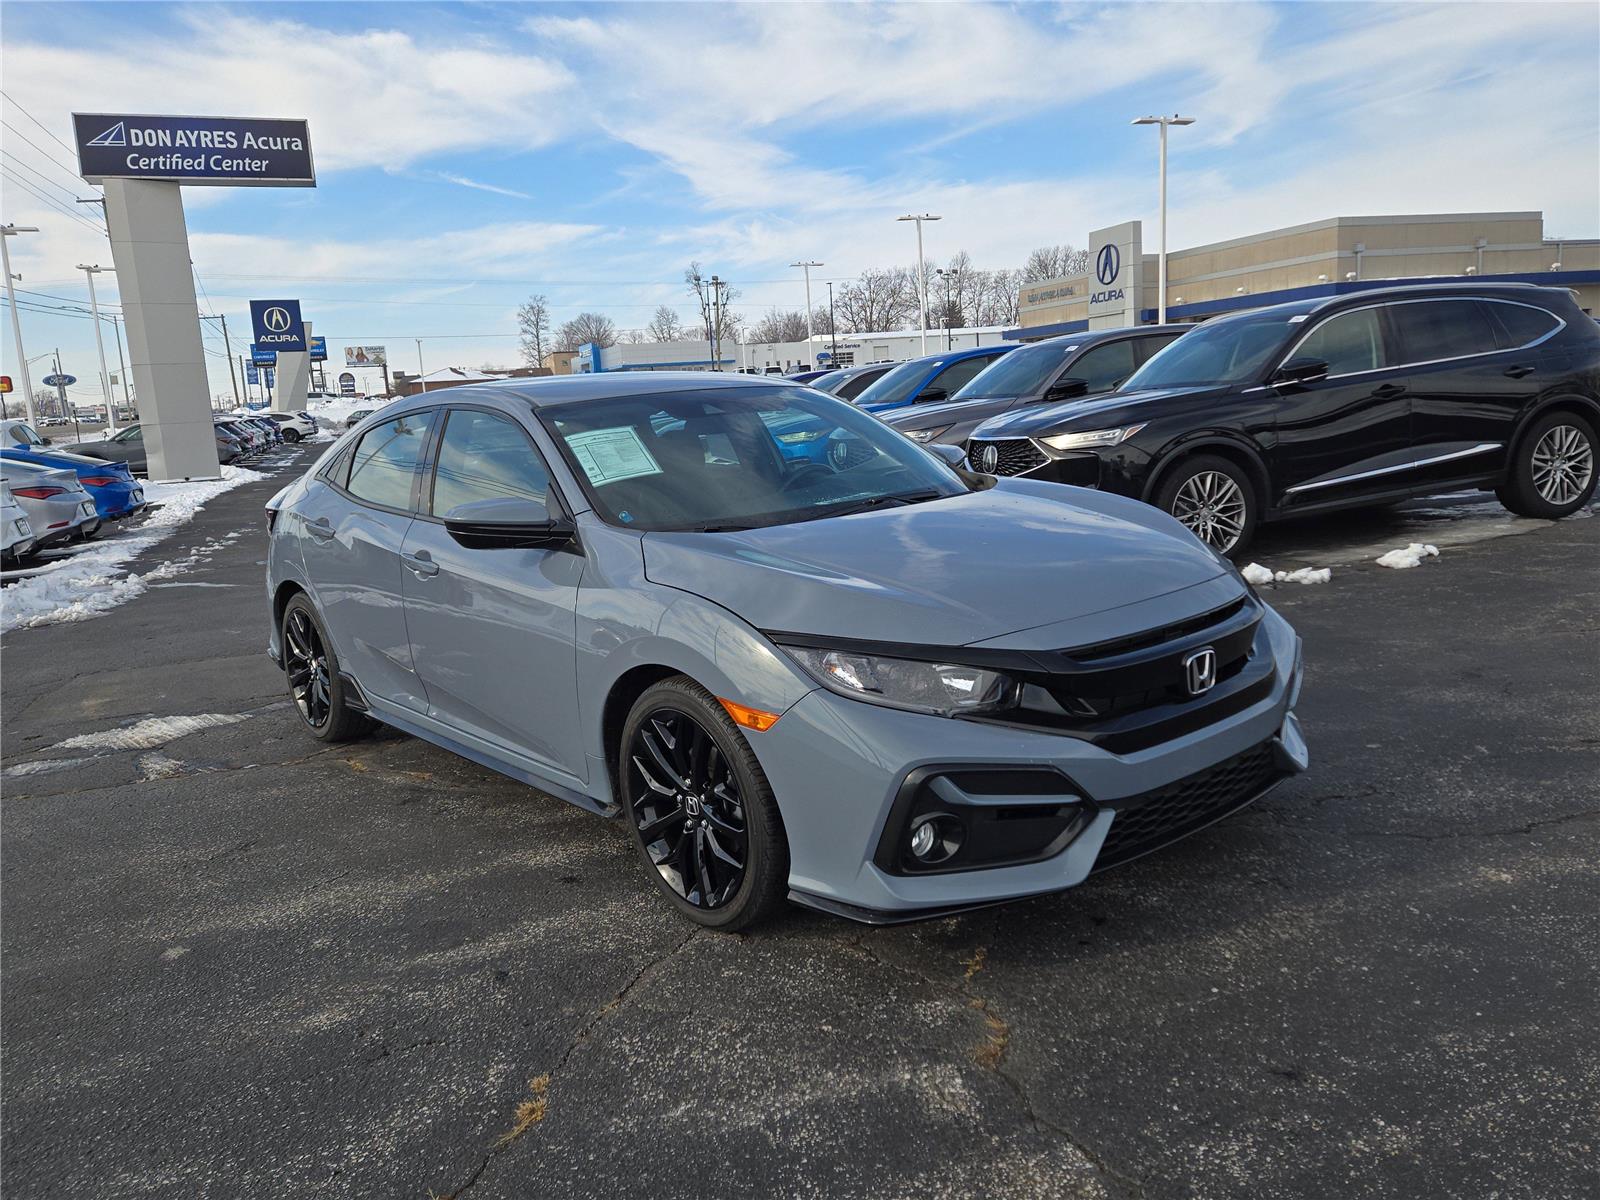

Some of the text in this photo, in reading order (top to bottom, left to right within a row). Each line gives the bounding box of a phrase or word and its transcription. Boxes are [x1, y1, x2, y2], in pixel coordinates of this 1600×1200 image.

[130, 129, 303, 151] DON AYRES Acura
[126, 153, 269, 172] Certified Center
[1090, 289, 1124, 304] ACURA
[259, 334, 299, 342] ACURA
